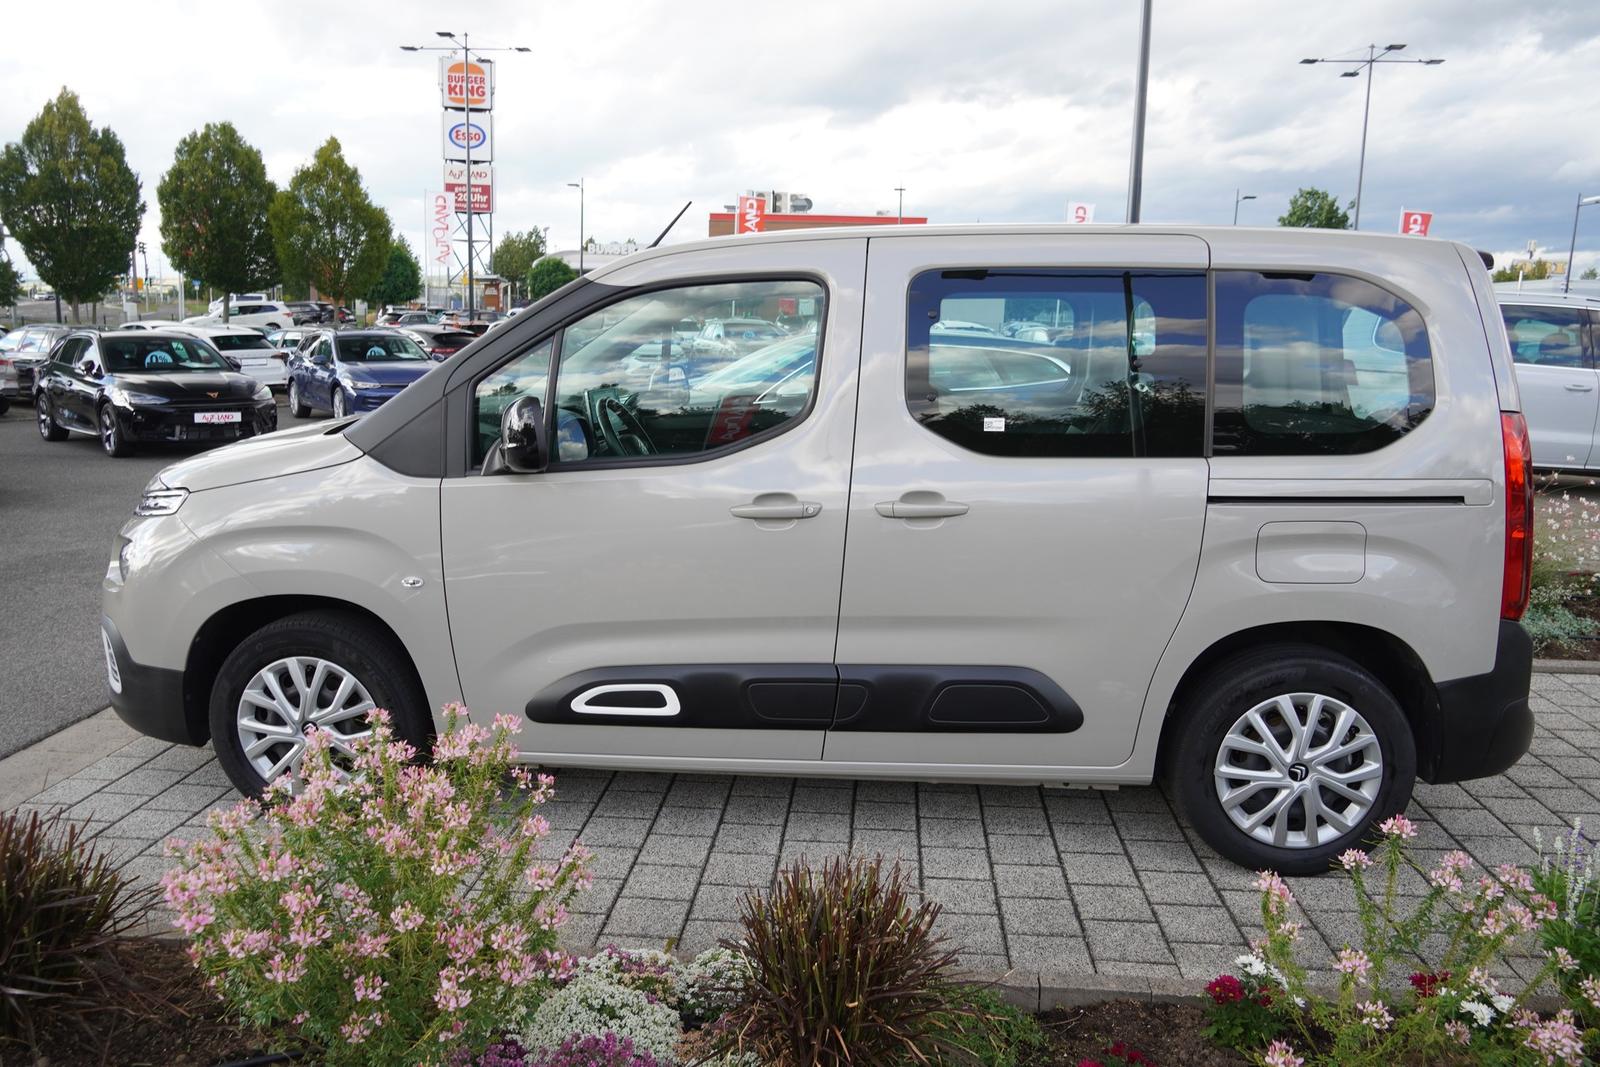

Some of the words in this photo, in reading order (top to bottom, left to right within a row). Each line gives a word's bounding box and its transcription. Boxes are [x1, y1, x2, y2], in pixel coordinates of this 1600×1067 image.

[447, 74, 486, 85] BURGER
[447, 84, 486, 97] KING
[470, 193, 489, 203] Uhr
